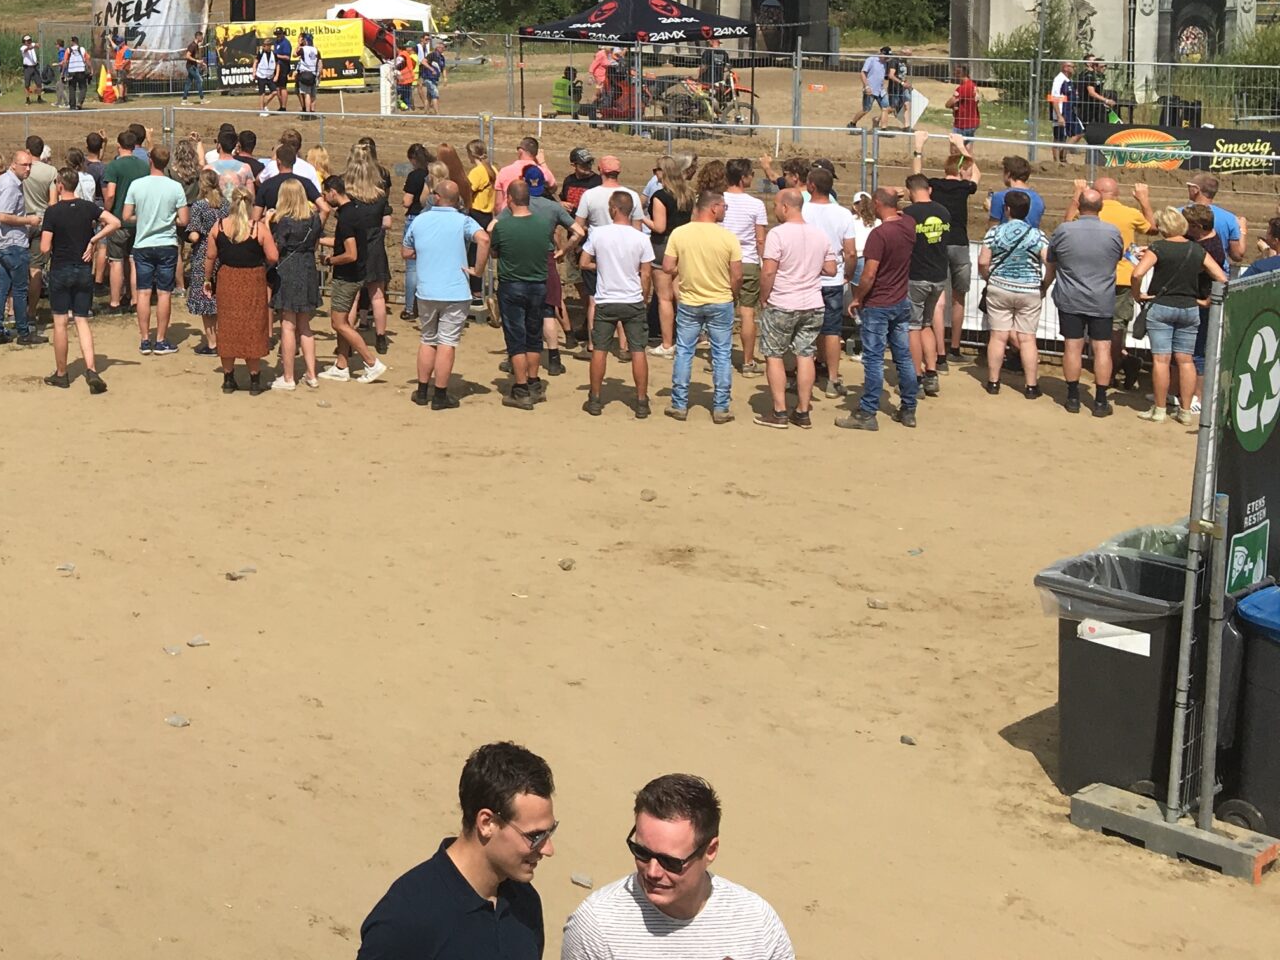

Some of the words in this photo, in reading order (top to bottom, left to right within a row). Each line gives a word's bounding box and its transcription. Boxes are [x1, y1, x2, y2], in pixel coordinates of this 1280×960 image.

[285, 27, 297, 37] De
[300, 25, 342, 35] Melkbus
[649, 30, 687, 42] 24MX
[713, 26, 748, 36] 24MX
[1213, 138, 1272, 155] Smerig
[1209, 151, 1276, 169] Lekker!
[1246, 495, 1266, 515] ETENS
